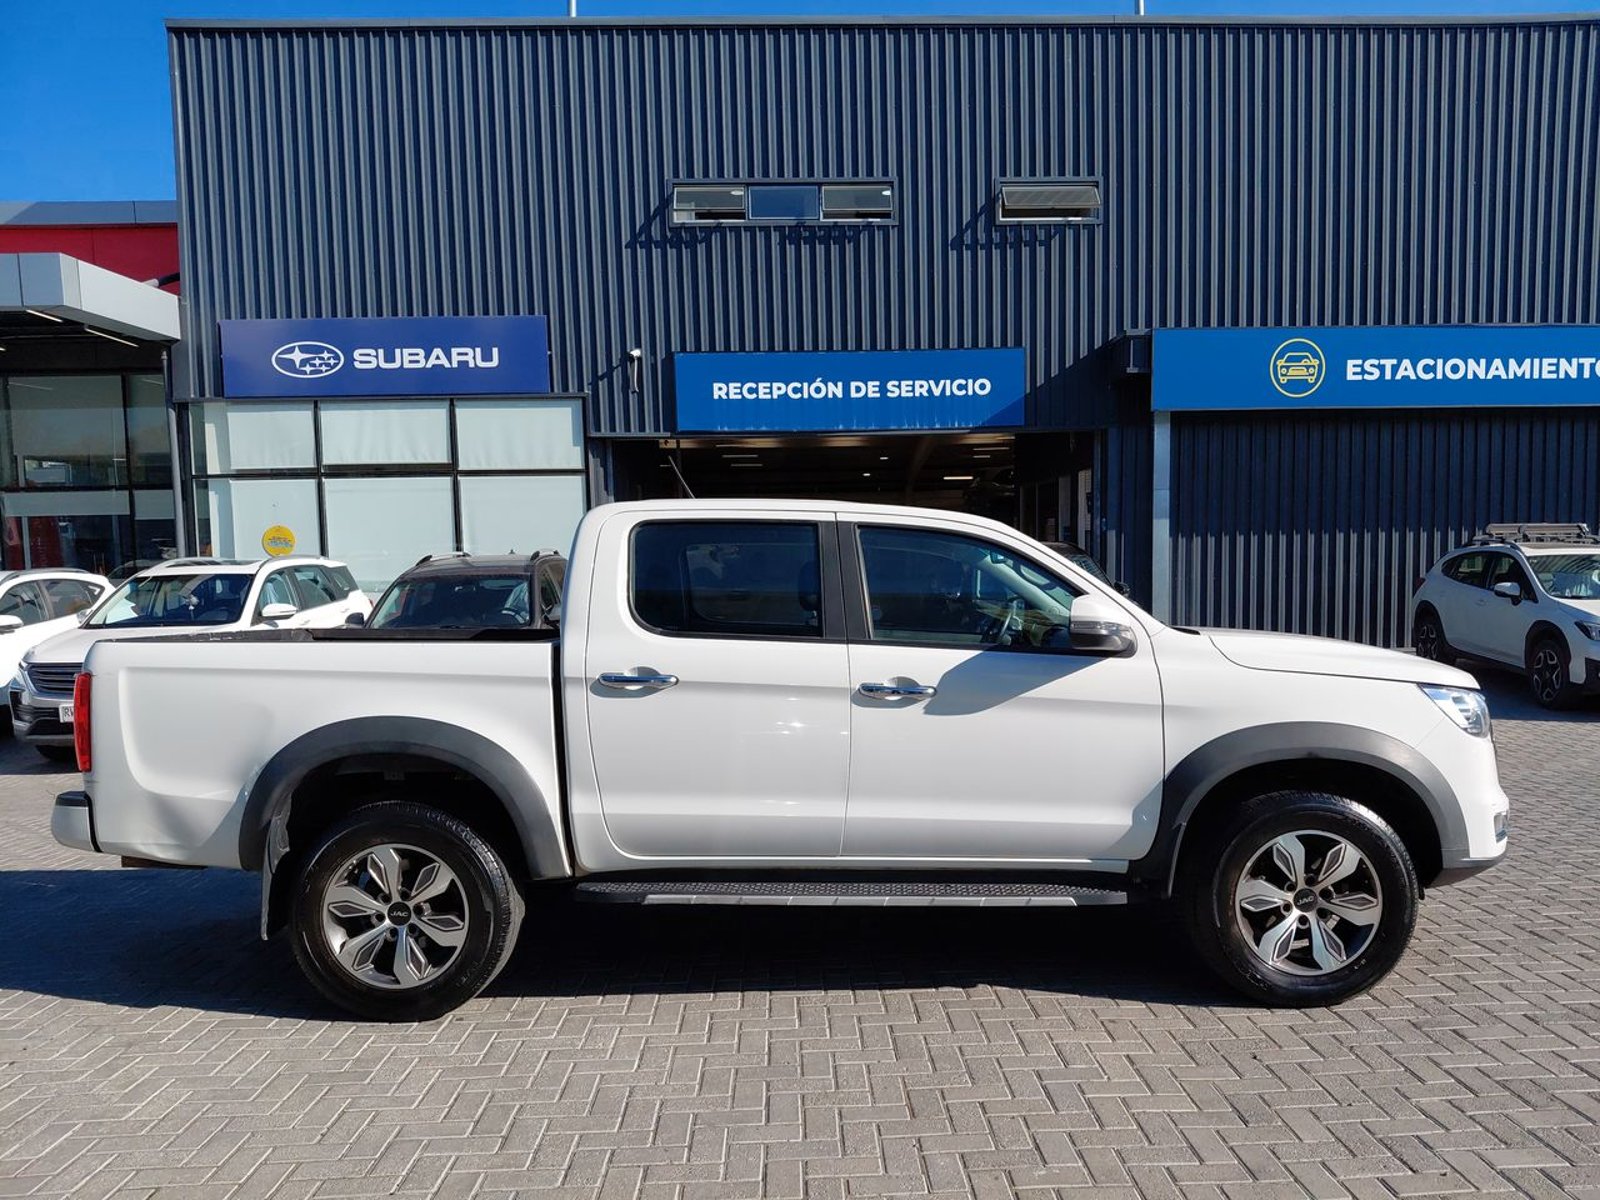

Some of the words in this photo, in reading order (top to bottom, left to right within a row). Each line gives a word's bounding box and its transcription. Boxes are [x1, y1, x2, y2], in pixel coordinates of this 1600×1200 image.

[353, 347, 499, 369] SUBARU
[1346, 357, 1600, 381] ESTACIONAMIENT
[712, 377, 843, 400] RECEPCIÓN
[850, 380, 880, 398] DE
[886, 378, 991, 398] SERVICIO
[1297, 895, 1315, 905] JAC
